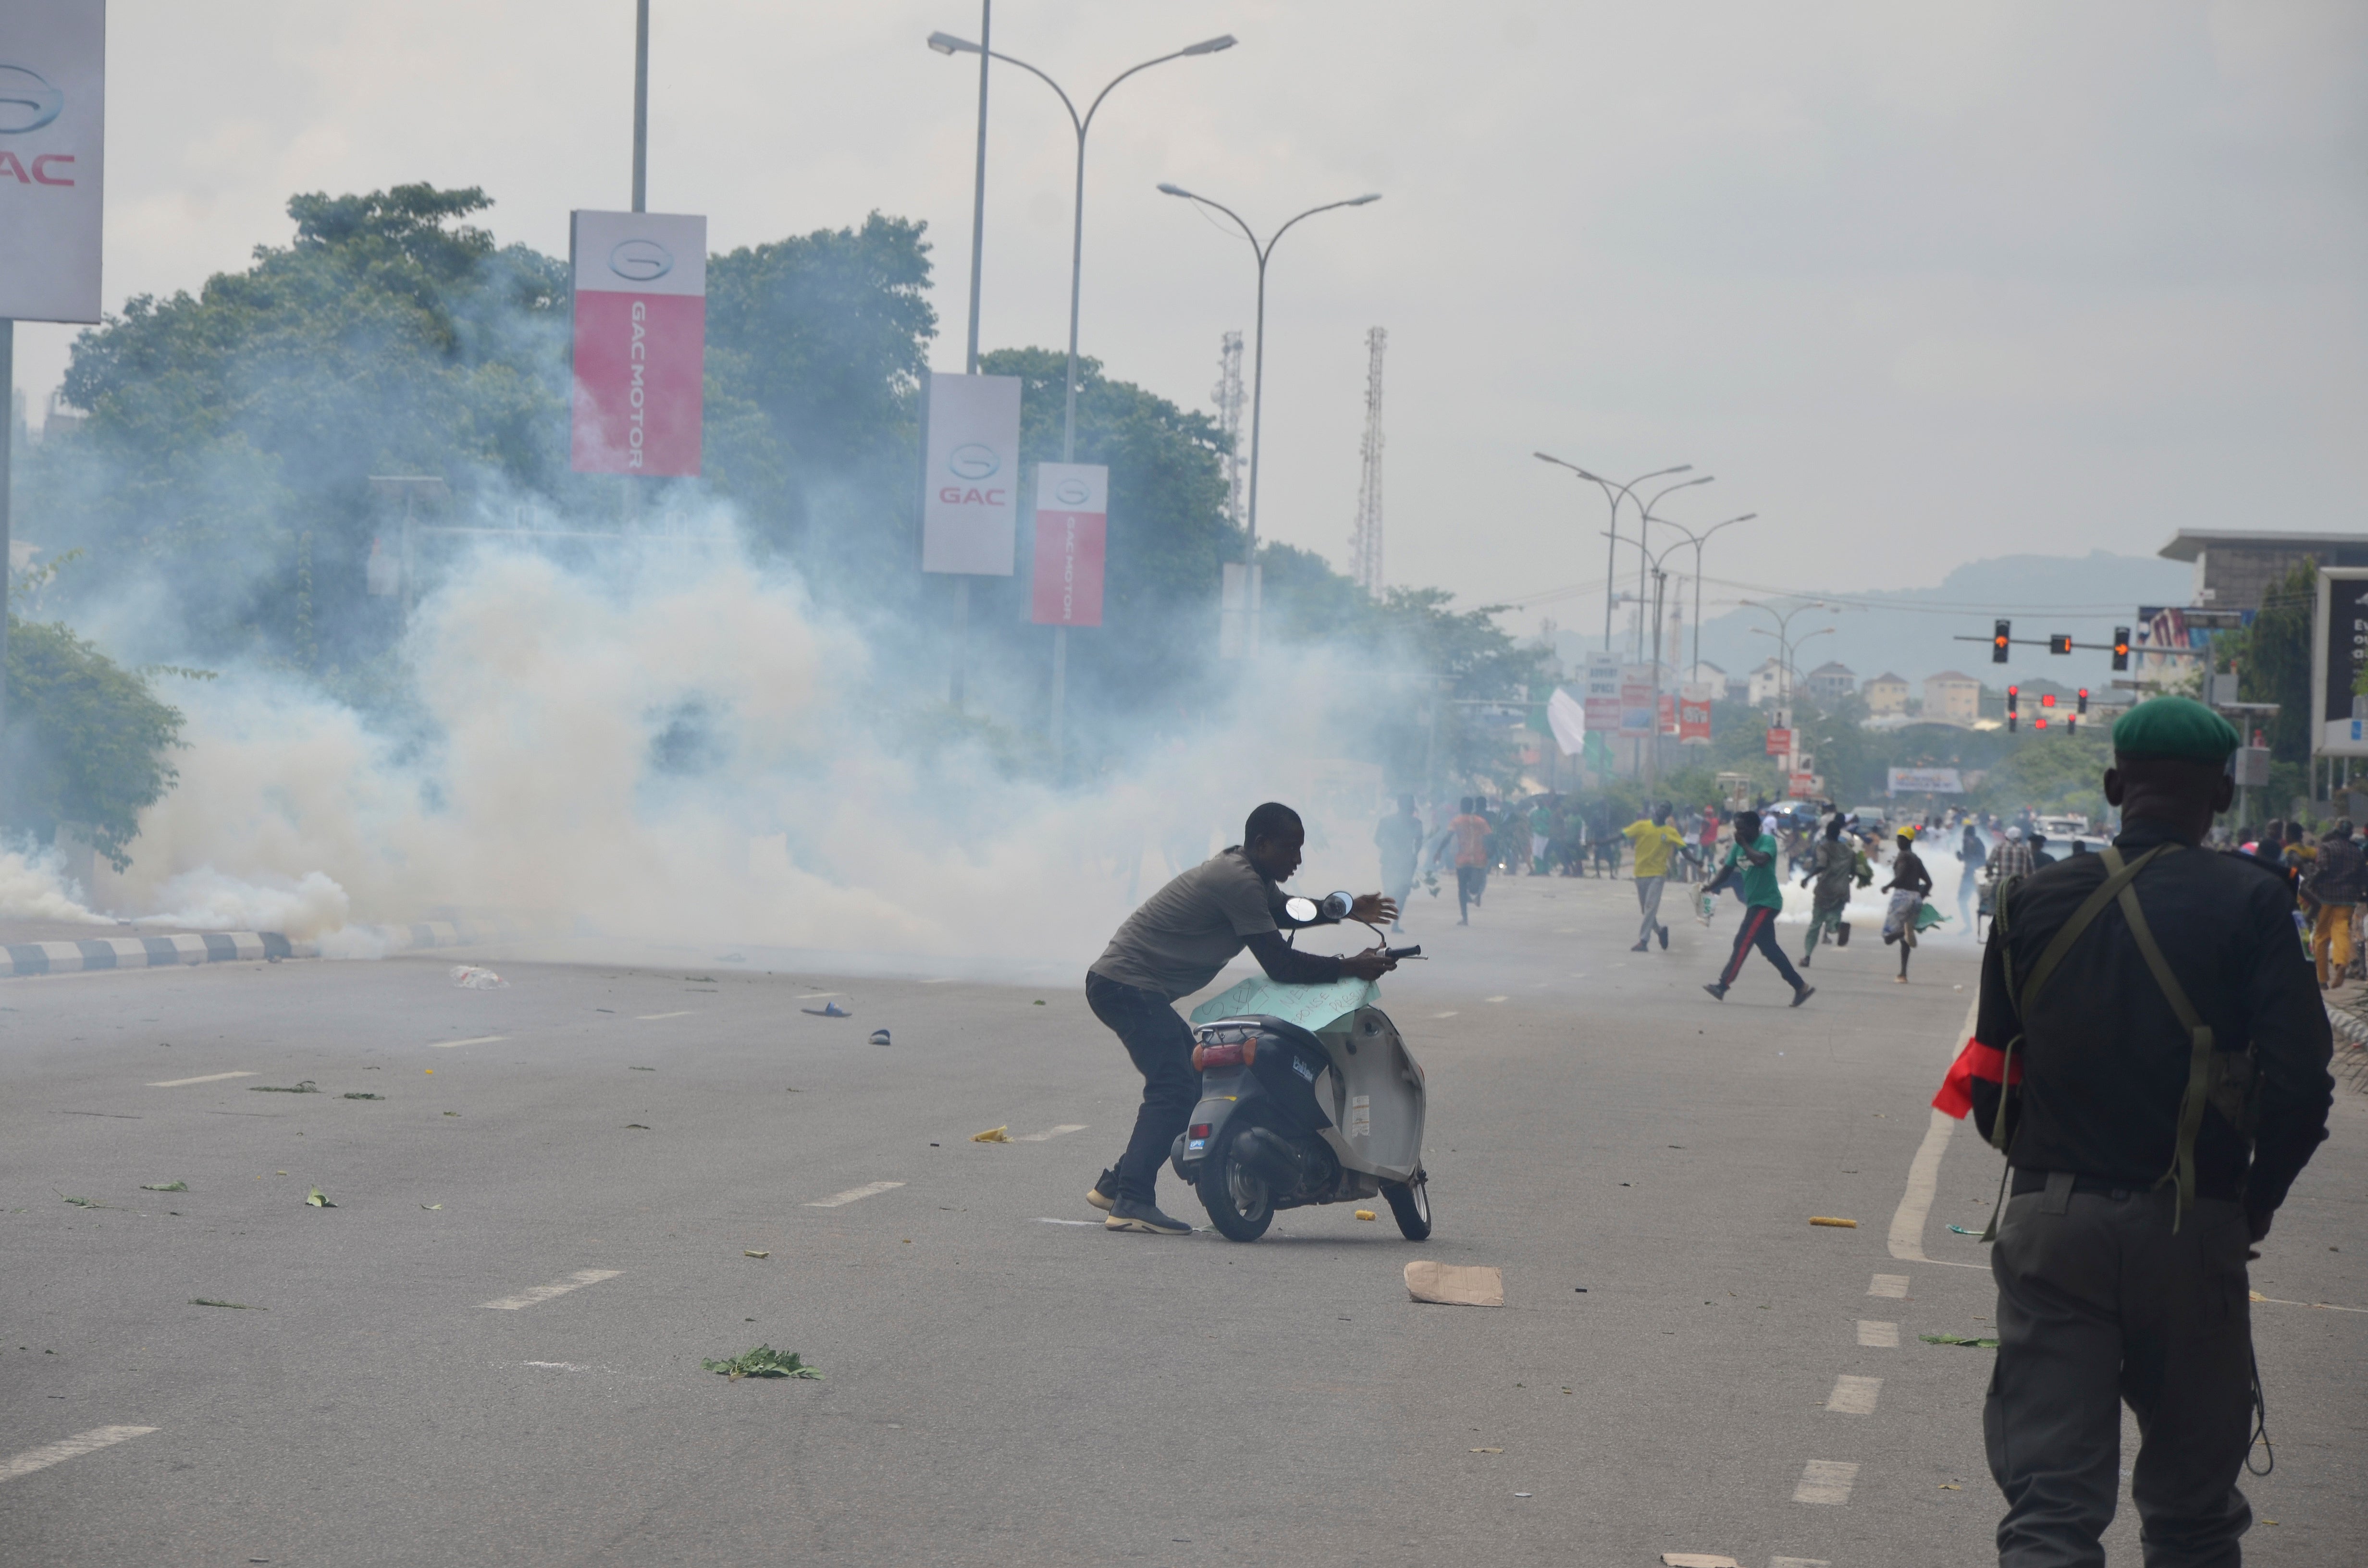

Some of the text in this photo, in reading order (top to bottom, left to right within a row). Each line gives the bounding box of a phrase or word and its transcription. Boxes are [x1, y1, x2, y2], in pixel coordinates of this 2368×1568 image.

[629, 301, 645, 468] GAC MOTOR
[940, 487, 1005, 505] GAC
[1063, 556, 1074, 620] MOTOR
